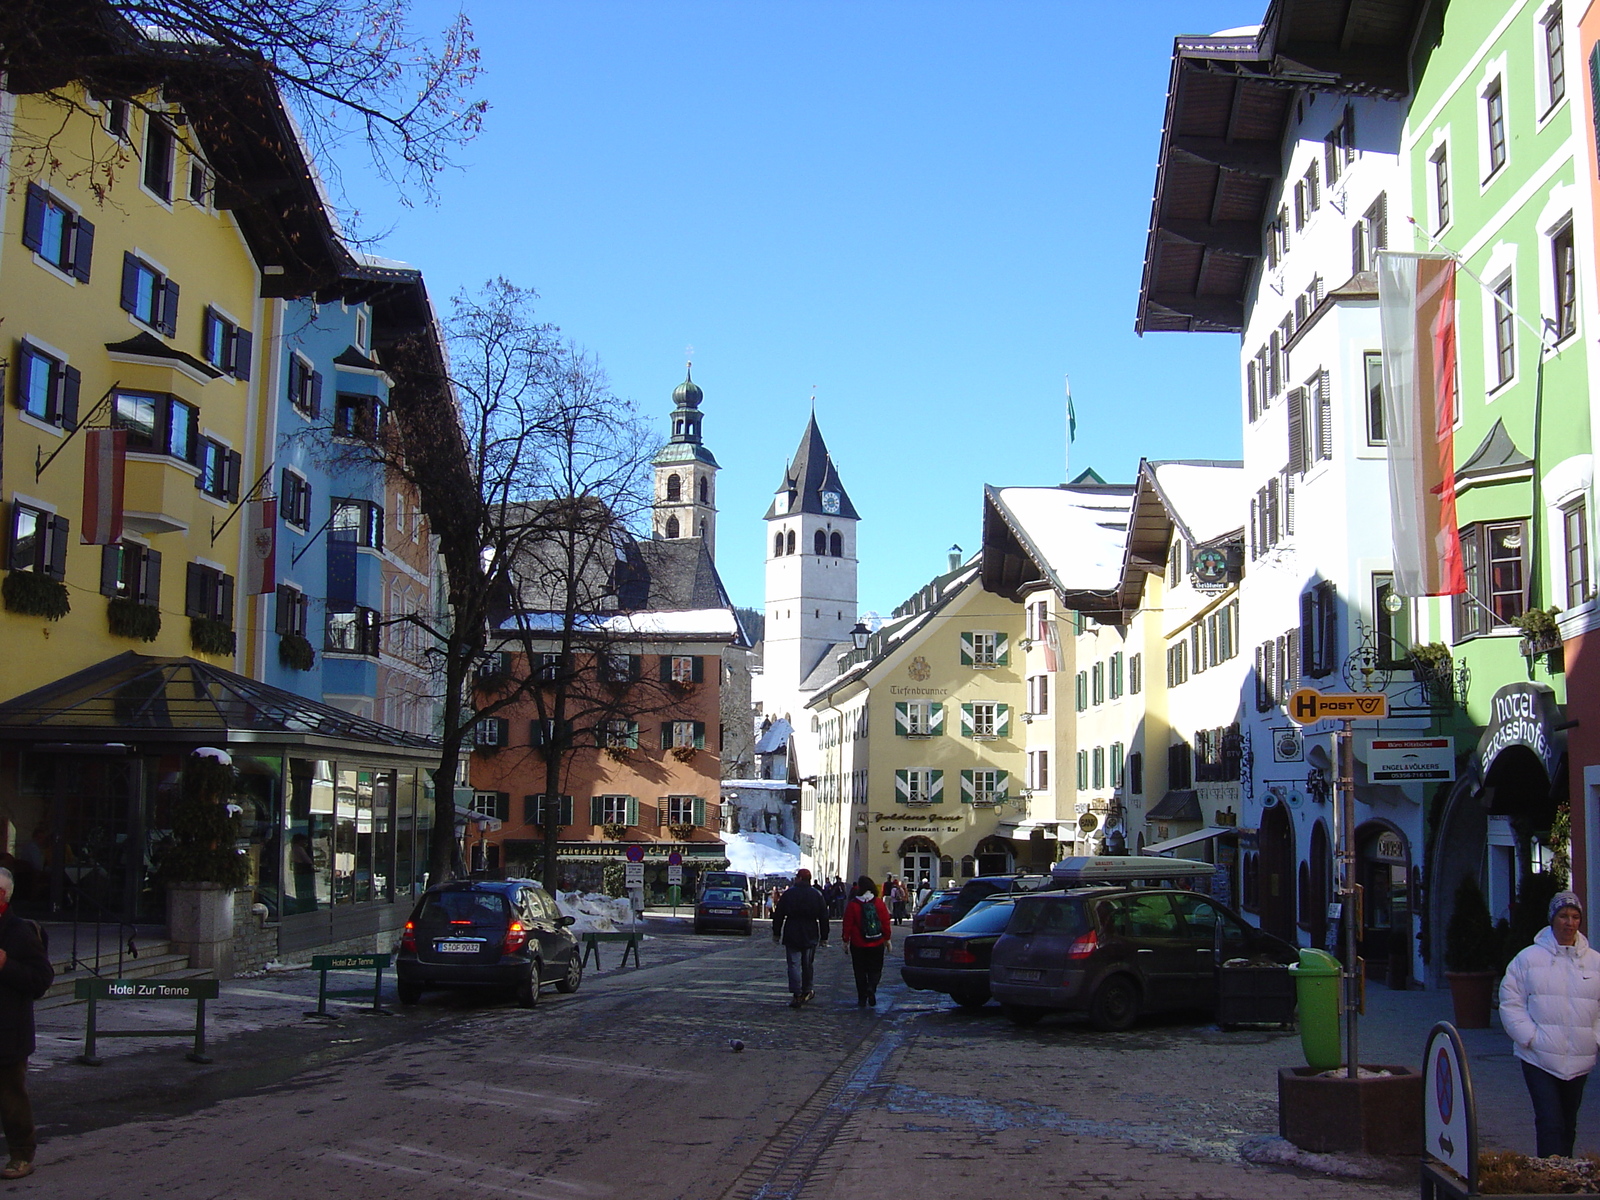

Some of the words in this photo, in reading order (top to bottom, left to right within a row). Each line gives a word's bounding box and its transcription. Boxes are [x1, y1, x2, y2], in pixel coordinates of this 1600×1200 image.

[889, 685, 948, 696] Tiefenbrunner
[1296, 695, 1317, 717] H
[1320, 702, 1355, 710] POST
[556, 846, 621, 856] schenkstube
[332, 959, 347, 967] Hotel
[347, 958, 357, 966] Zur
[358, 957, 374, 966] Tenne
[108, 984, 136, 995] Hotel
[138, 984, 157, 996] Zur
[158, 985, 190, 996] Tenne
